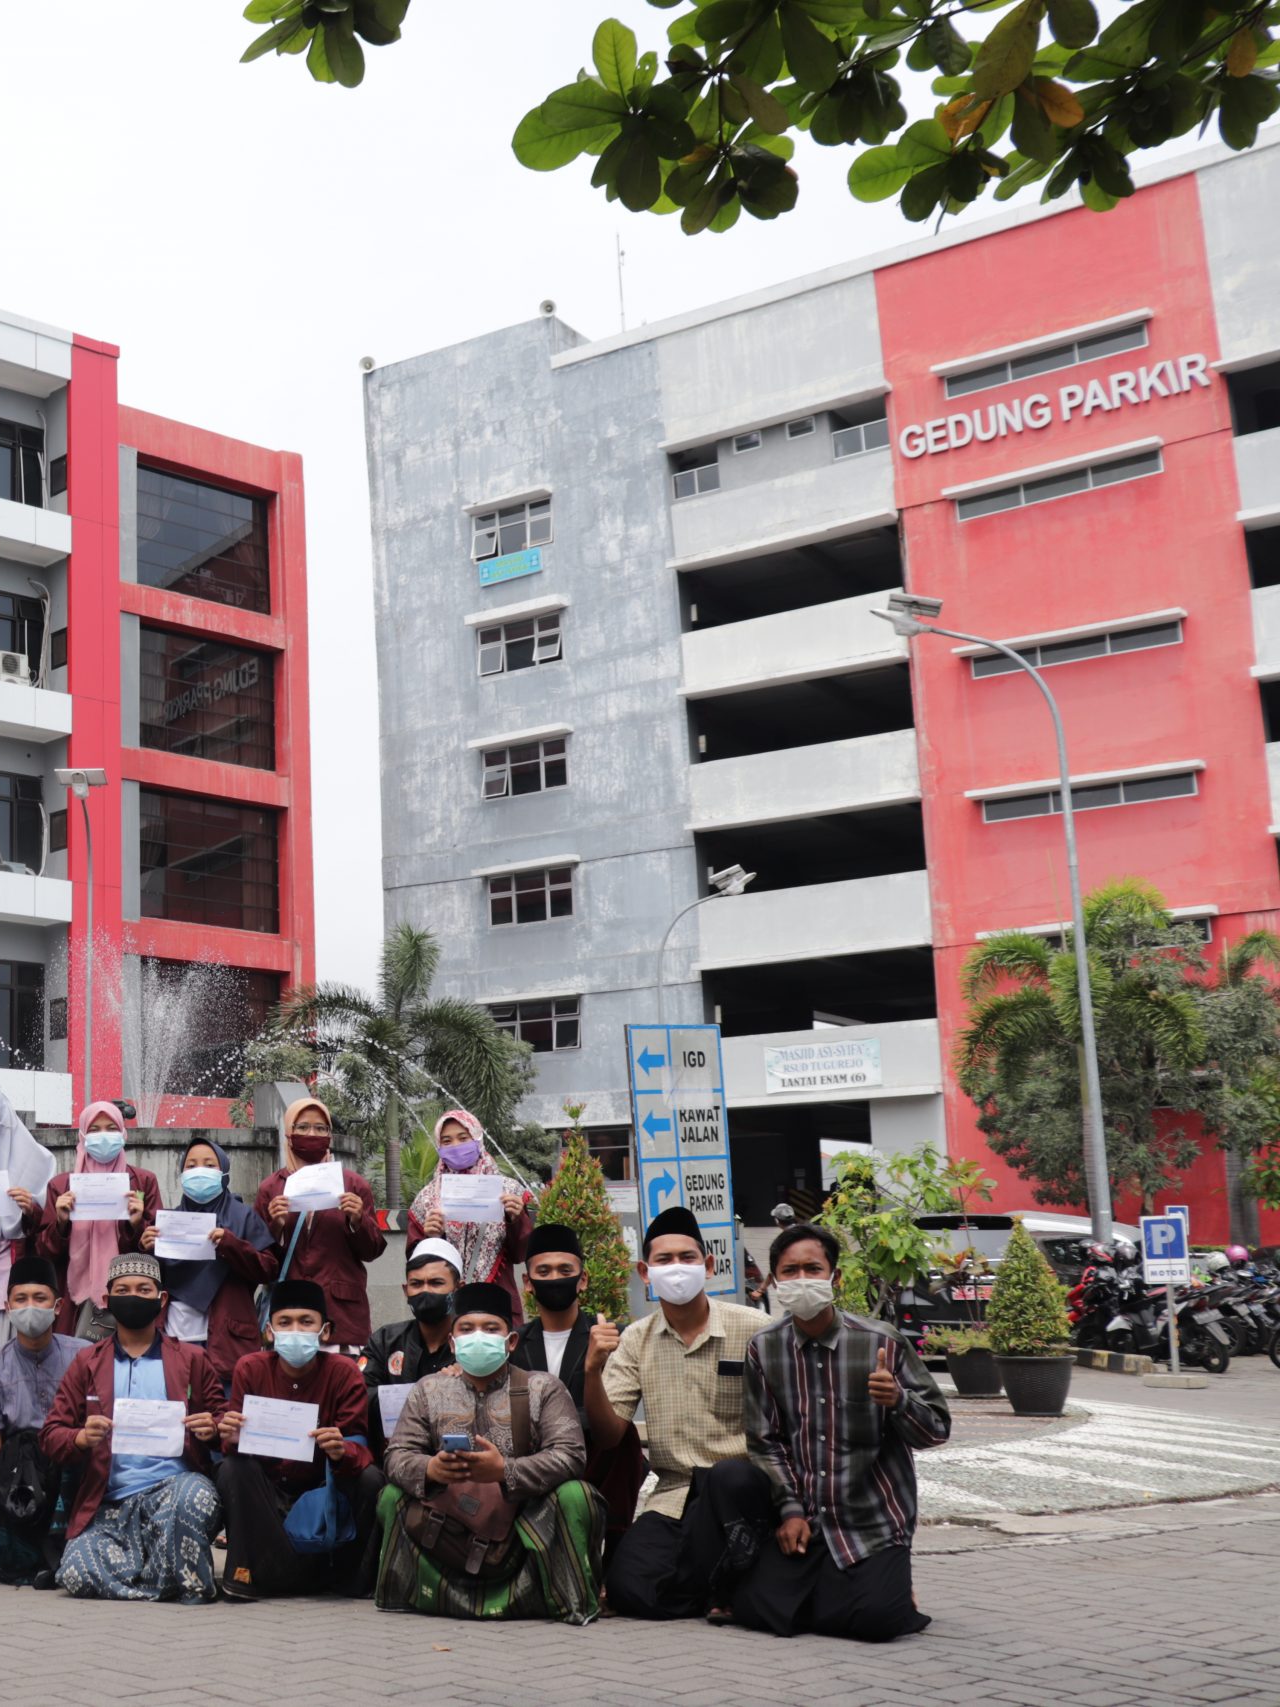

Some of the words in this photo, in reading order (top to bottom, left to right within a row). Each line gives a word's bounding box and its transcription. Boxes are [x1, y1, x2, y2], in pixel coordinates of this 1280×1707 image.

[899, 394, 1052, 458] GEDUNG
[1060, 353, 1211, 421] PARKIR
[683, 1051, 706, 1068] IGD
[820, 1074, 848, 1086] ENAM
[679, 1105, 720, 1123] RAWAT
[680, 1126, 719, 1143] JALAN
[685, 1173, 725, 1192] GEDUNG
[689, 1194, 725, 1212] PARKIR
[705, 1239, 727, 1255] NTU
[1150, 1224, 1176, 1255] P
